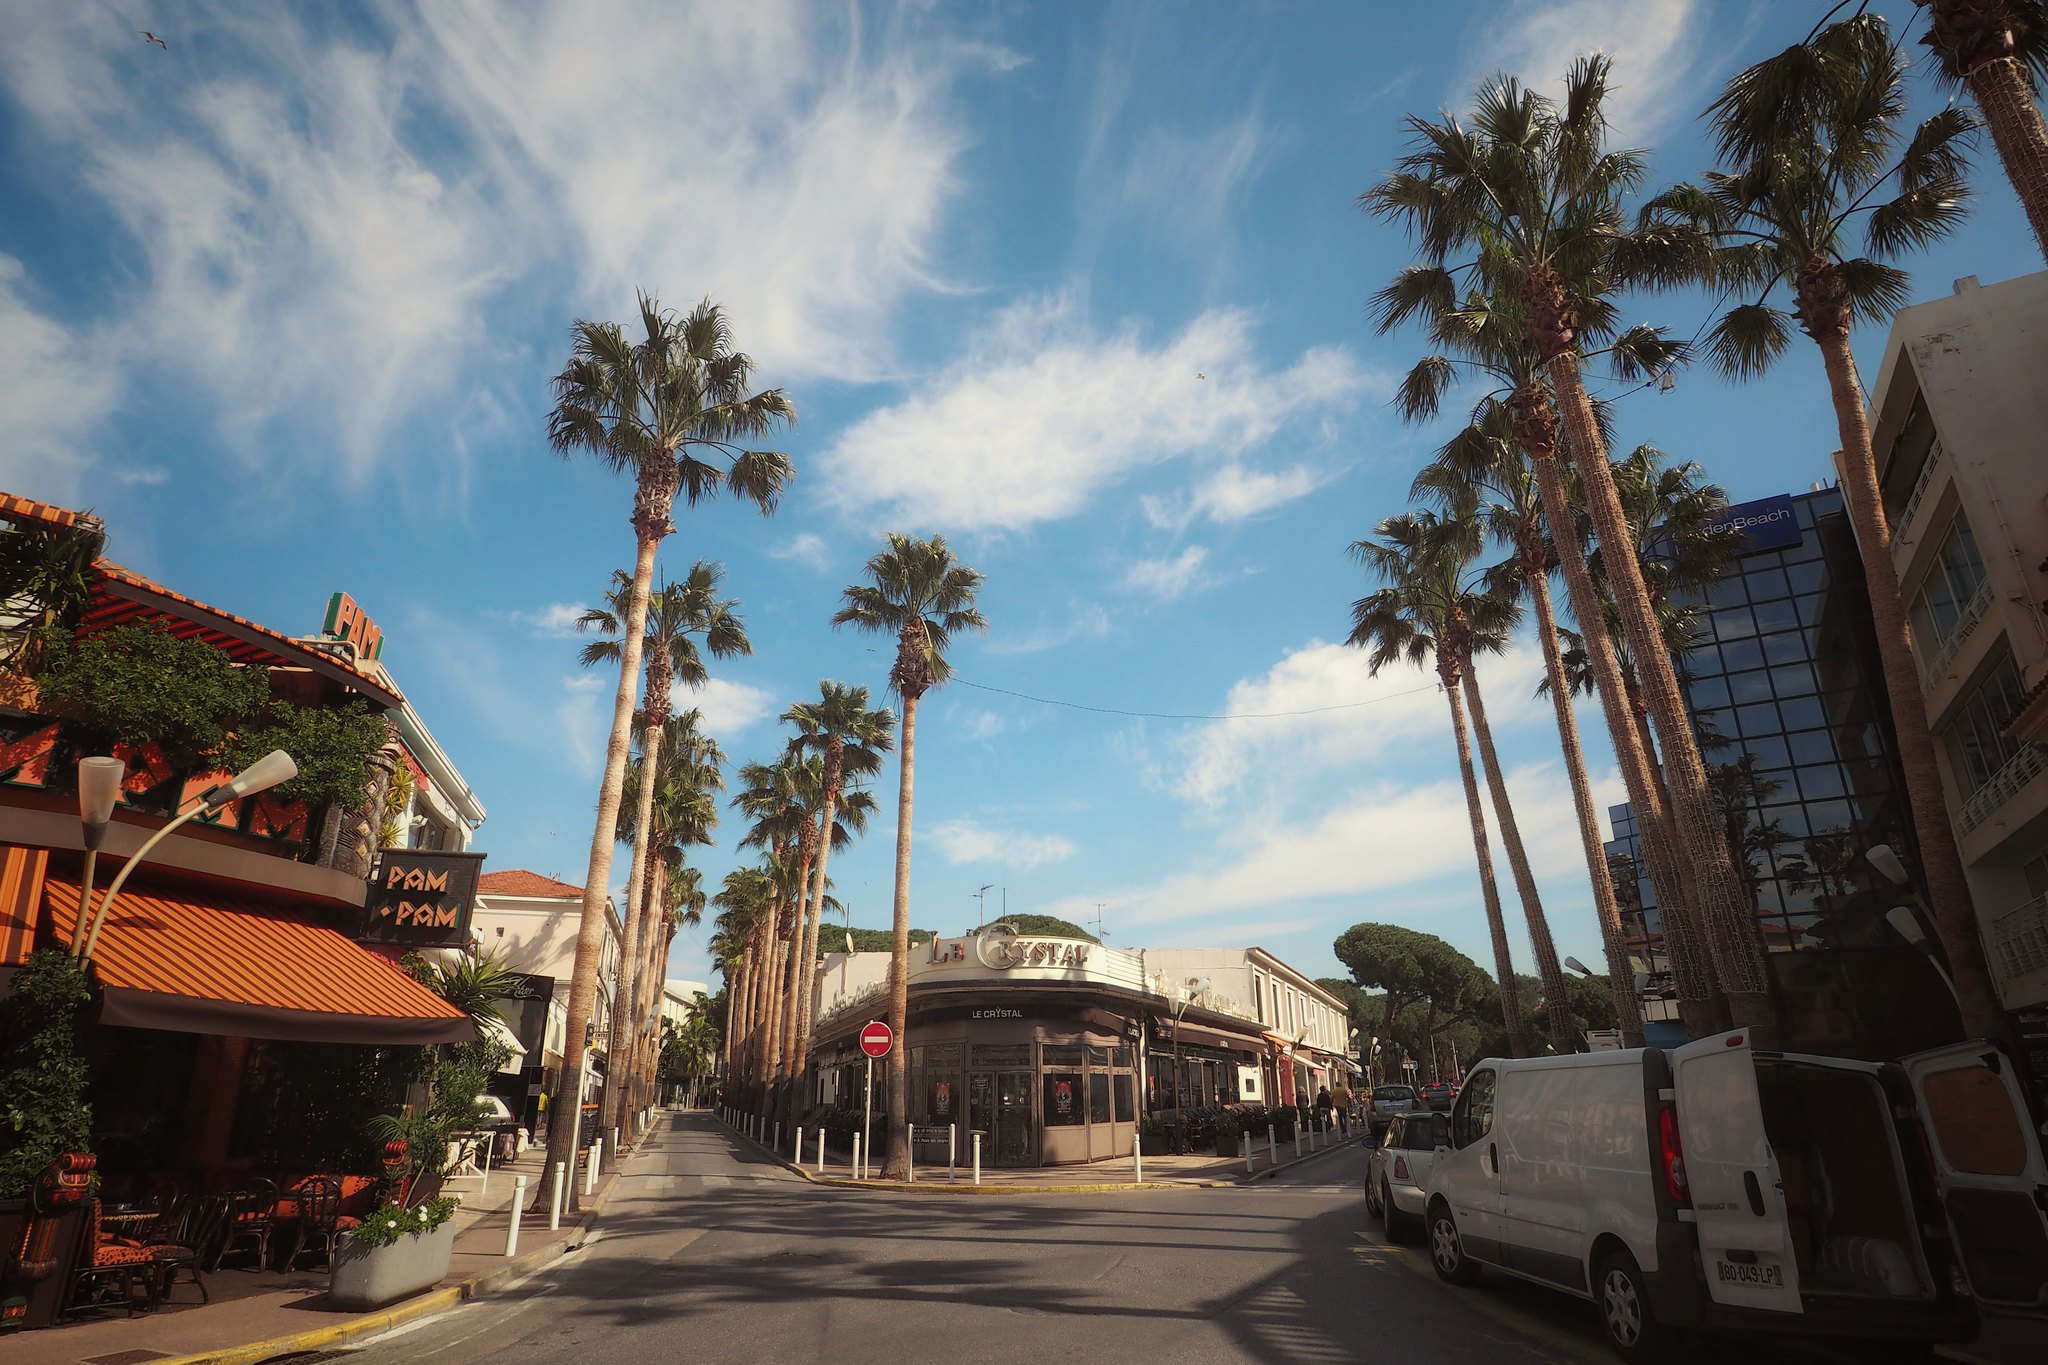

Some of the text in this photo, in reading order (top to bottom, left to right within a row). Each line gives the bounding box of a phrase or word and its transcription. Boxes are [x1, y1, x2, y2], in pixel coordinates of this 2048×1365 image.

[329, 592, 383, 661] PAM
[387, 866, 448, 892] PAM
[395, 901, 459, 928] PAM
[926, 922, 1088, 970] LE CRYSTAL
[972, 1010, 982, 1019] LE
[1724, 1264, 1774, 1284] BD-049-LP
